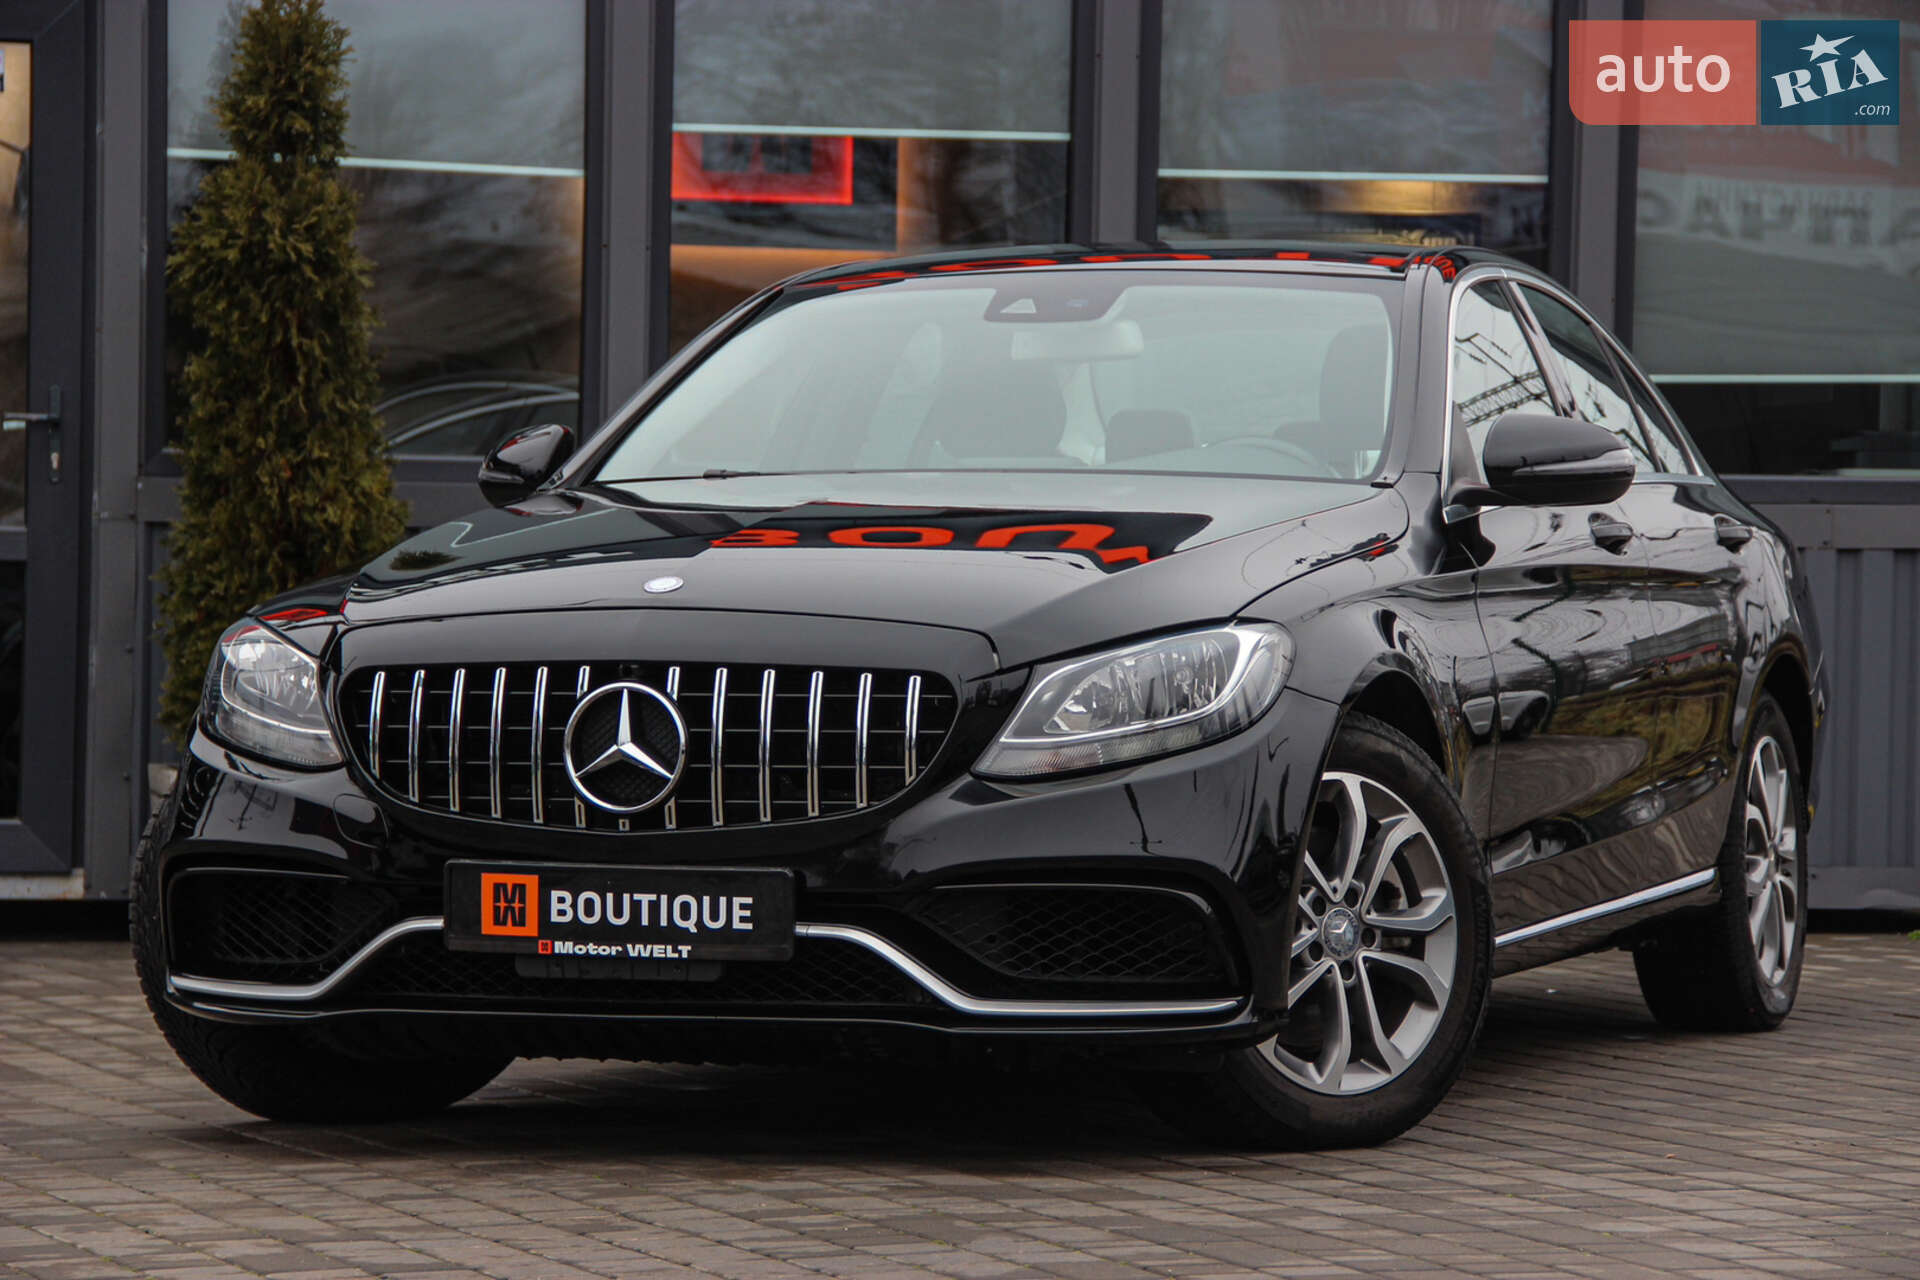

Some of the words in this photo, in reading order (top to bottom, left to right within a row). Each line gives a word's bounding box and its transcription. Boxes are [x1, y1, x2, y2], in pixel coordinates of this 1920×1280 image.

[550, 889, 754, 933] BOUTIQUE
[554, 941, 623, 956] Motor
[627, 943, 692, 958] WELT
